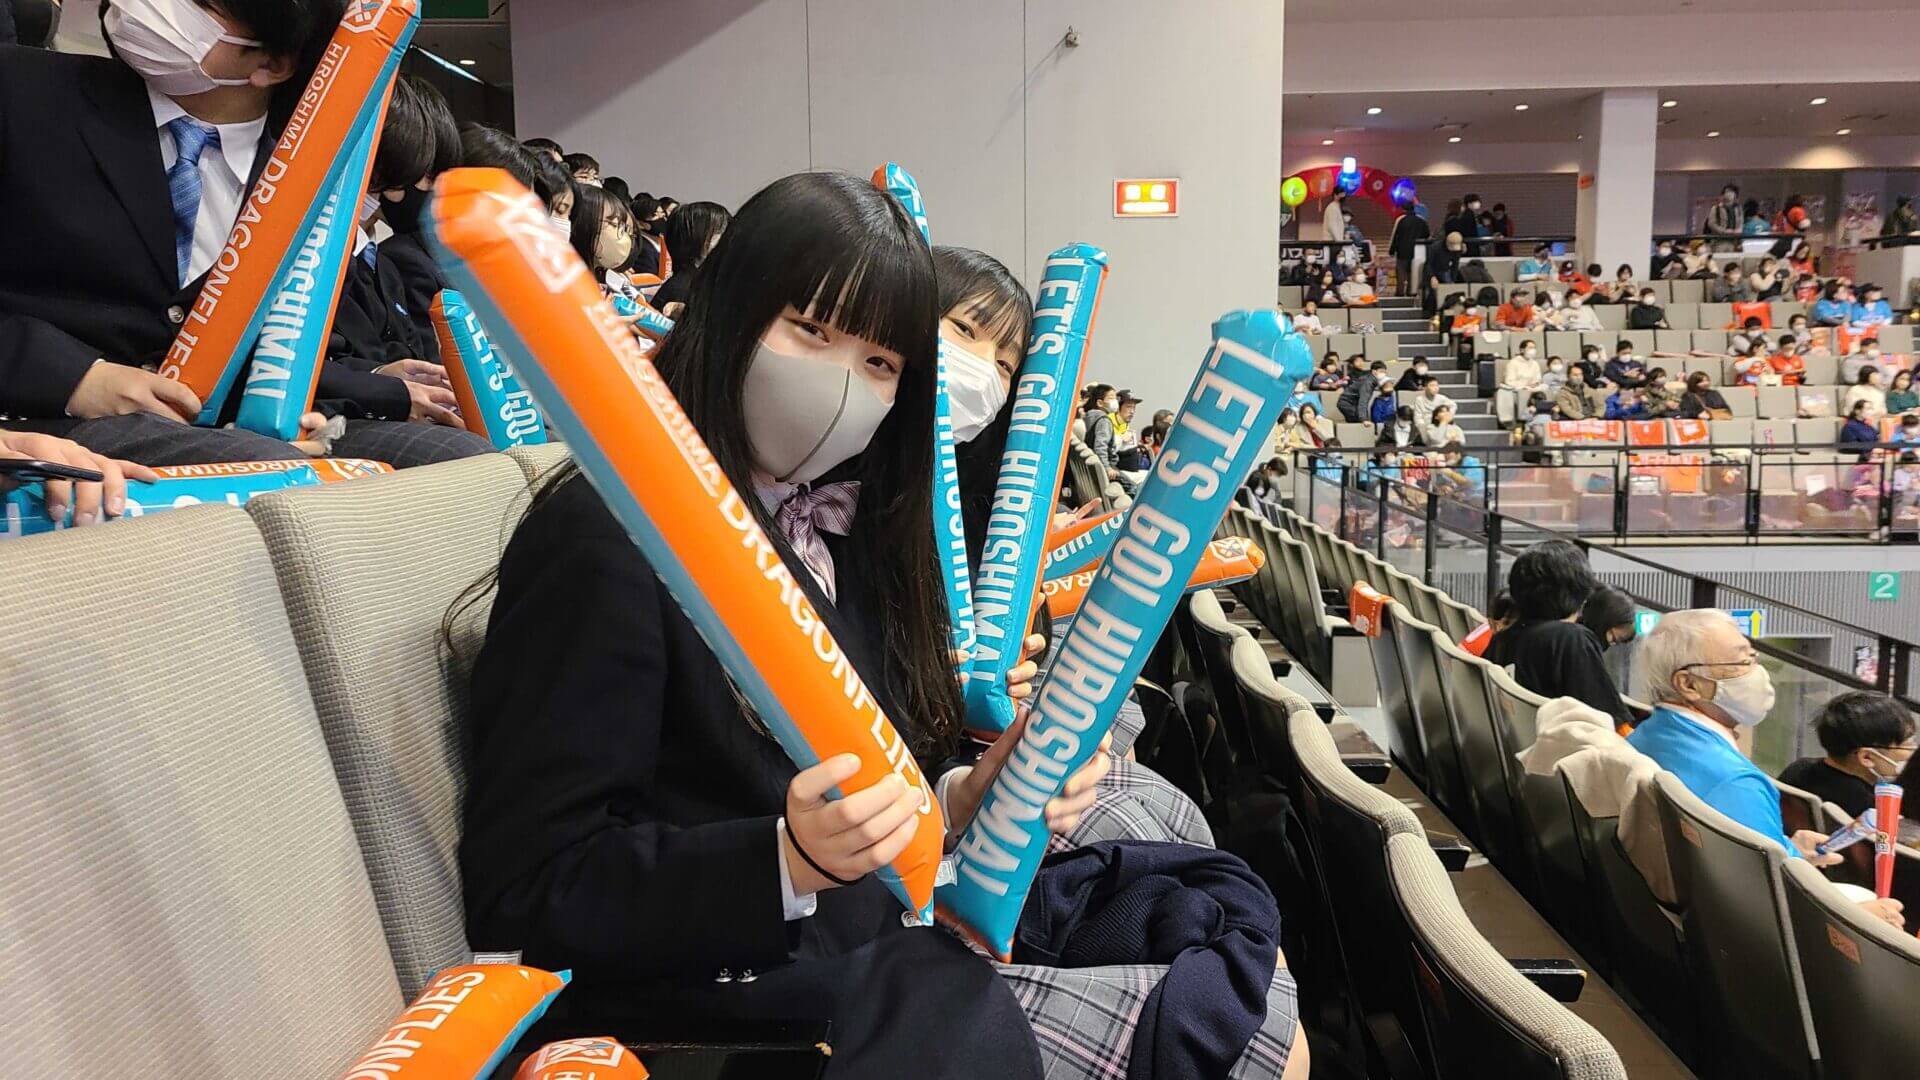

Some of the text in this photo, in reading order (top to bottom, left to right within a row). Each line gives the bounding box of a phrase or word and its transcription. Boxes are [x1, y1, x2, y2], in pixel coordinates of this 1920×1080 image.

[157, 42, 343, 382] HIROSHIMA DRAGONFLIES
[243, 193, 337, 400] ROSHIMA!
[465, 309, 515, 392] LETS
[971, 257, 1085, 683] LET'S GO! HIROSHIMA!
[953, 335, 1285, 897] LET'S GO! HIROSHIMA!
[1041, 569, 1097, 597] RAG
[1874, 573, 1896, 599] 2
